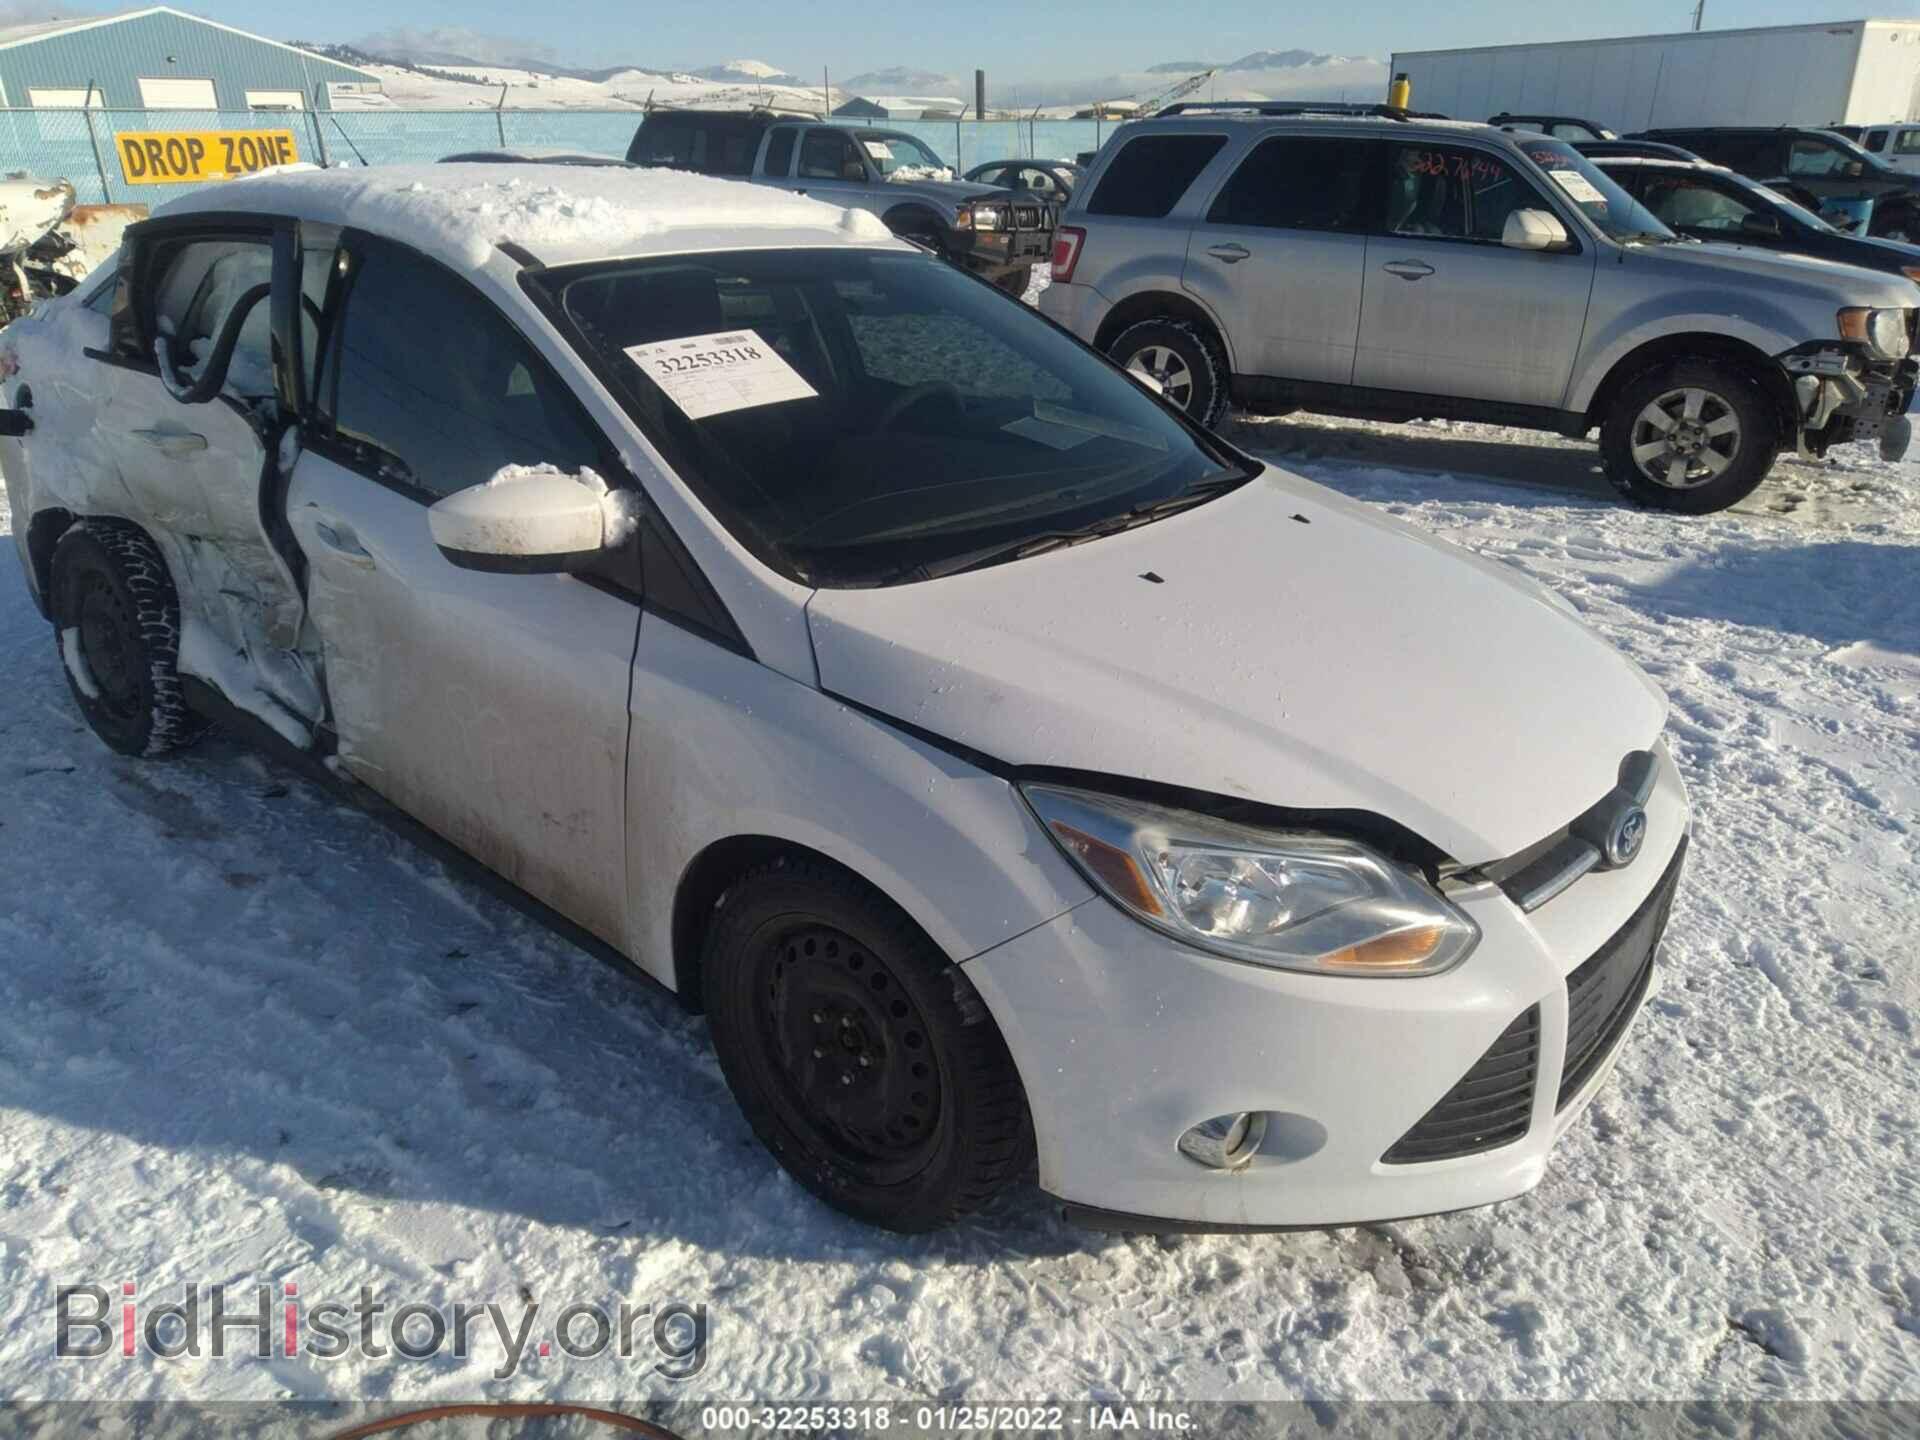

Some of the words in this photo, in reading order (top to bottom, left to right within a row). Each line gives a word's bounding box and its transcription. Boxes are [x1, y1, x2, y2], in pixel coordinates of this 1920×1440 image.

[122, 137, 205, 177] DROP
[219, 135, 292, 173] ZONE
[655, 346, 762, 375] 32253318
